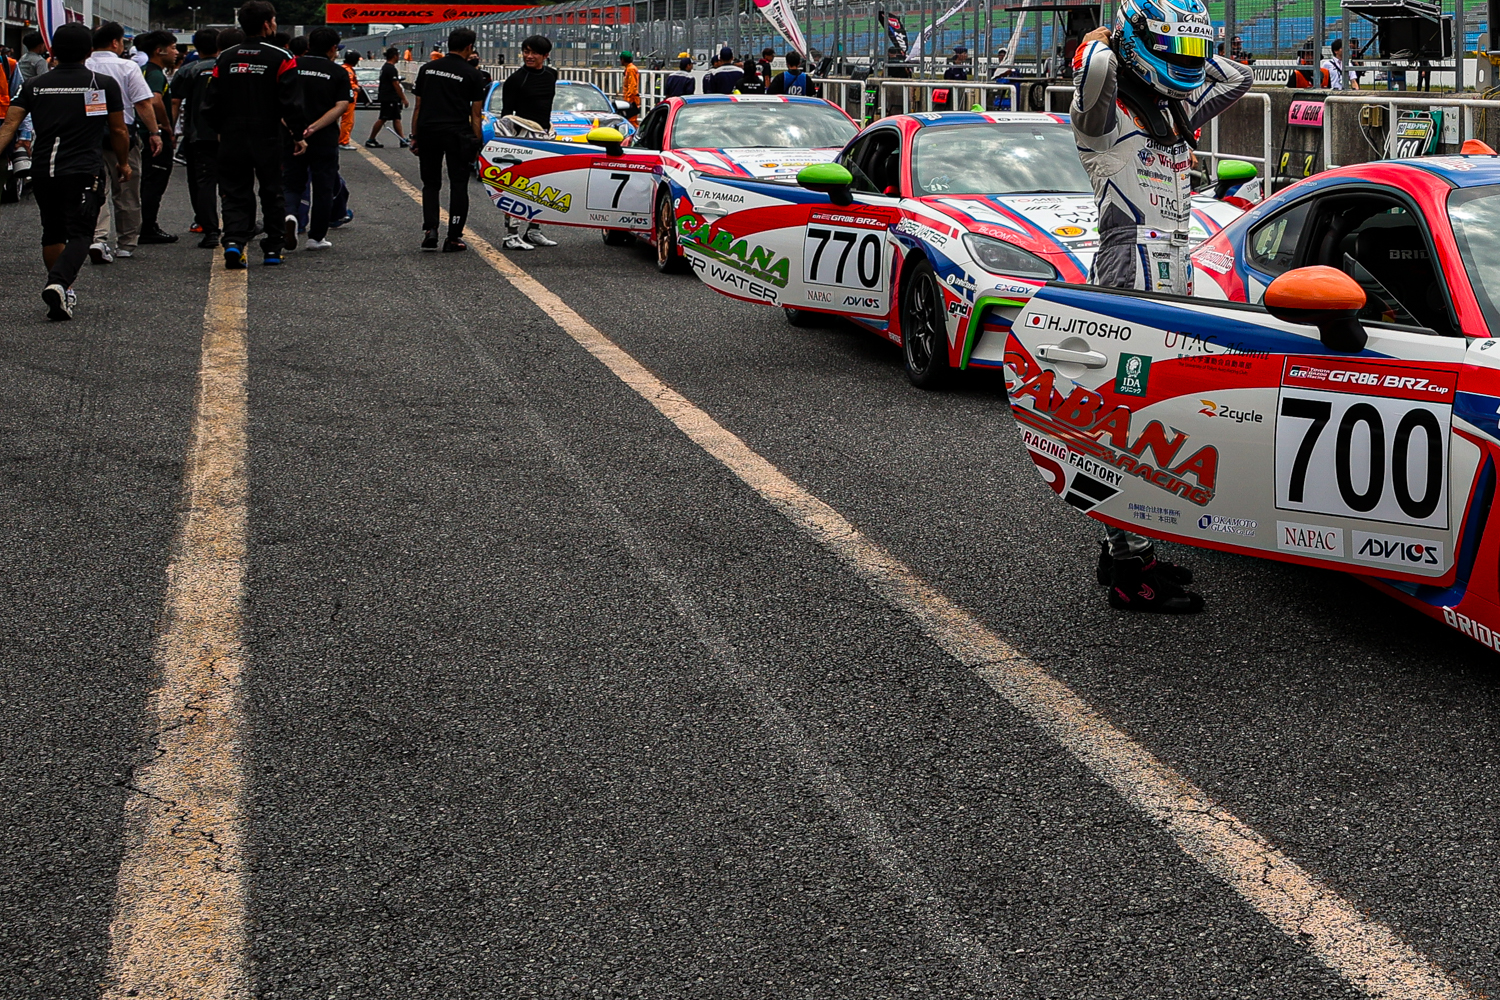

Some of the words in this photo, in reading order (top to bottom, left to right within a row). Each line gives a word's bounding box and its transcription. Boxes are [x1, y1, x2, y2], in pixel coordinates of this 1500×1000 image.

[359, 9, 434, 18] AUTOBACS
[91, 93, 99, 102] 2
[1290, 104, 1301, 120] 52
[1302, 105, 1322, 122] IGOR
[494, 146, 533, 155] Y.TSUTSUMI
[1280, 152, 1290, 174] P
[1303, 155, 1313, 177] 2
[483, 166, 573, 209] CABANA
[610, 173, 631, 209] 7
[703, 190, 745, 204] R.YAMADA
[1150, 192, 1178, 211] UTAC
[452, 215, 460, 224] 87
[589, 213, 610, 222] NAPAC
[676, 214, 790, 280] CABANA
[806, 227, 882, 289] 770
[710, 263, 779, 304] WATER
[995, 283, 1033, 295] EXEDY
[806, 289, 832, 303] NAPAC
[949, 302, 968, 315] gnd
[1047, 315, 1132, 342] H.JITOSHO
[1164, 330, 1218, 354] UTAC
[1220, 342, 1273, 361] Alumni
[1120, 386, 1142, 394] クリニック
[1123, 377, 1141, 389] IDA
[1289, 369, 1307, 378] GR
[1328, 369, 1430, 391] GR86/BRZ
[1428, 384, 1449, 395] Cup
[1004, 352, 1219, 489] CABANA
[1219, 405, 1263, 423] 2cycle
[1023, 430, 1067, 460] RACING
[1069, 453, 1123, 487] FACTORY
[1281, 397, 1443, 519] 700
[1114, 456, 1212, 506] RACING
[1210, 523, 1236, 534] GLASS
[1212, 514, 1258, 529] OKAMOTO
[1284, 527, 1337, 551] NAPAC
